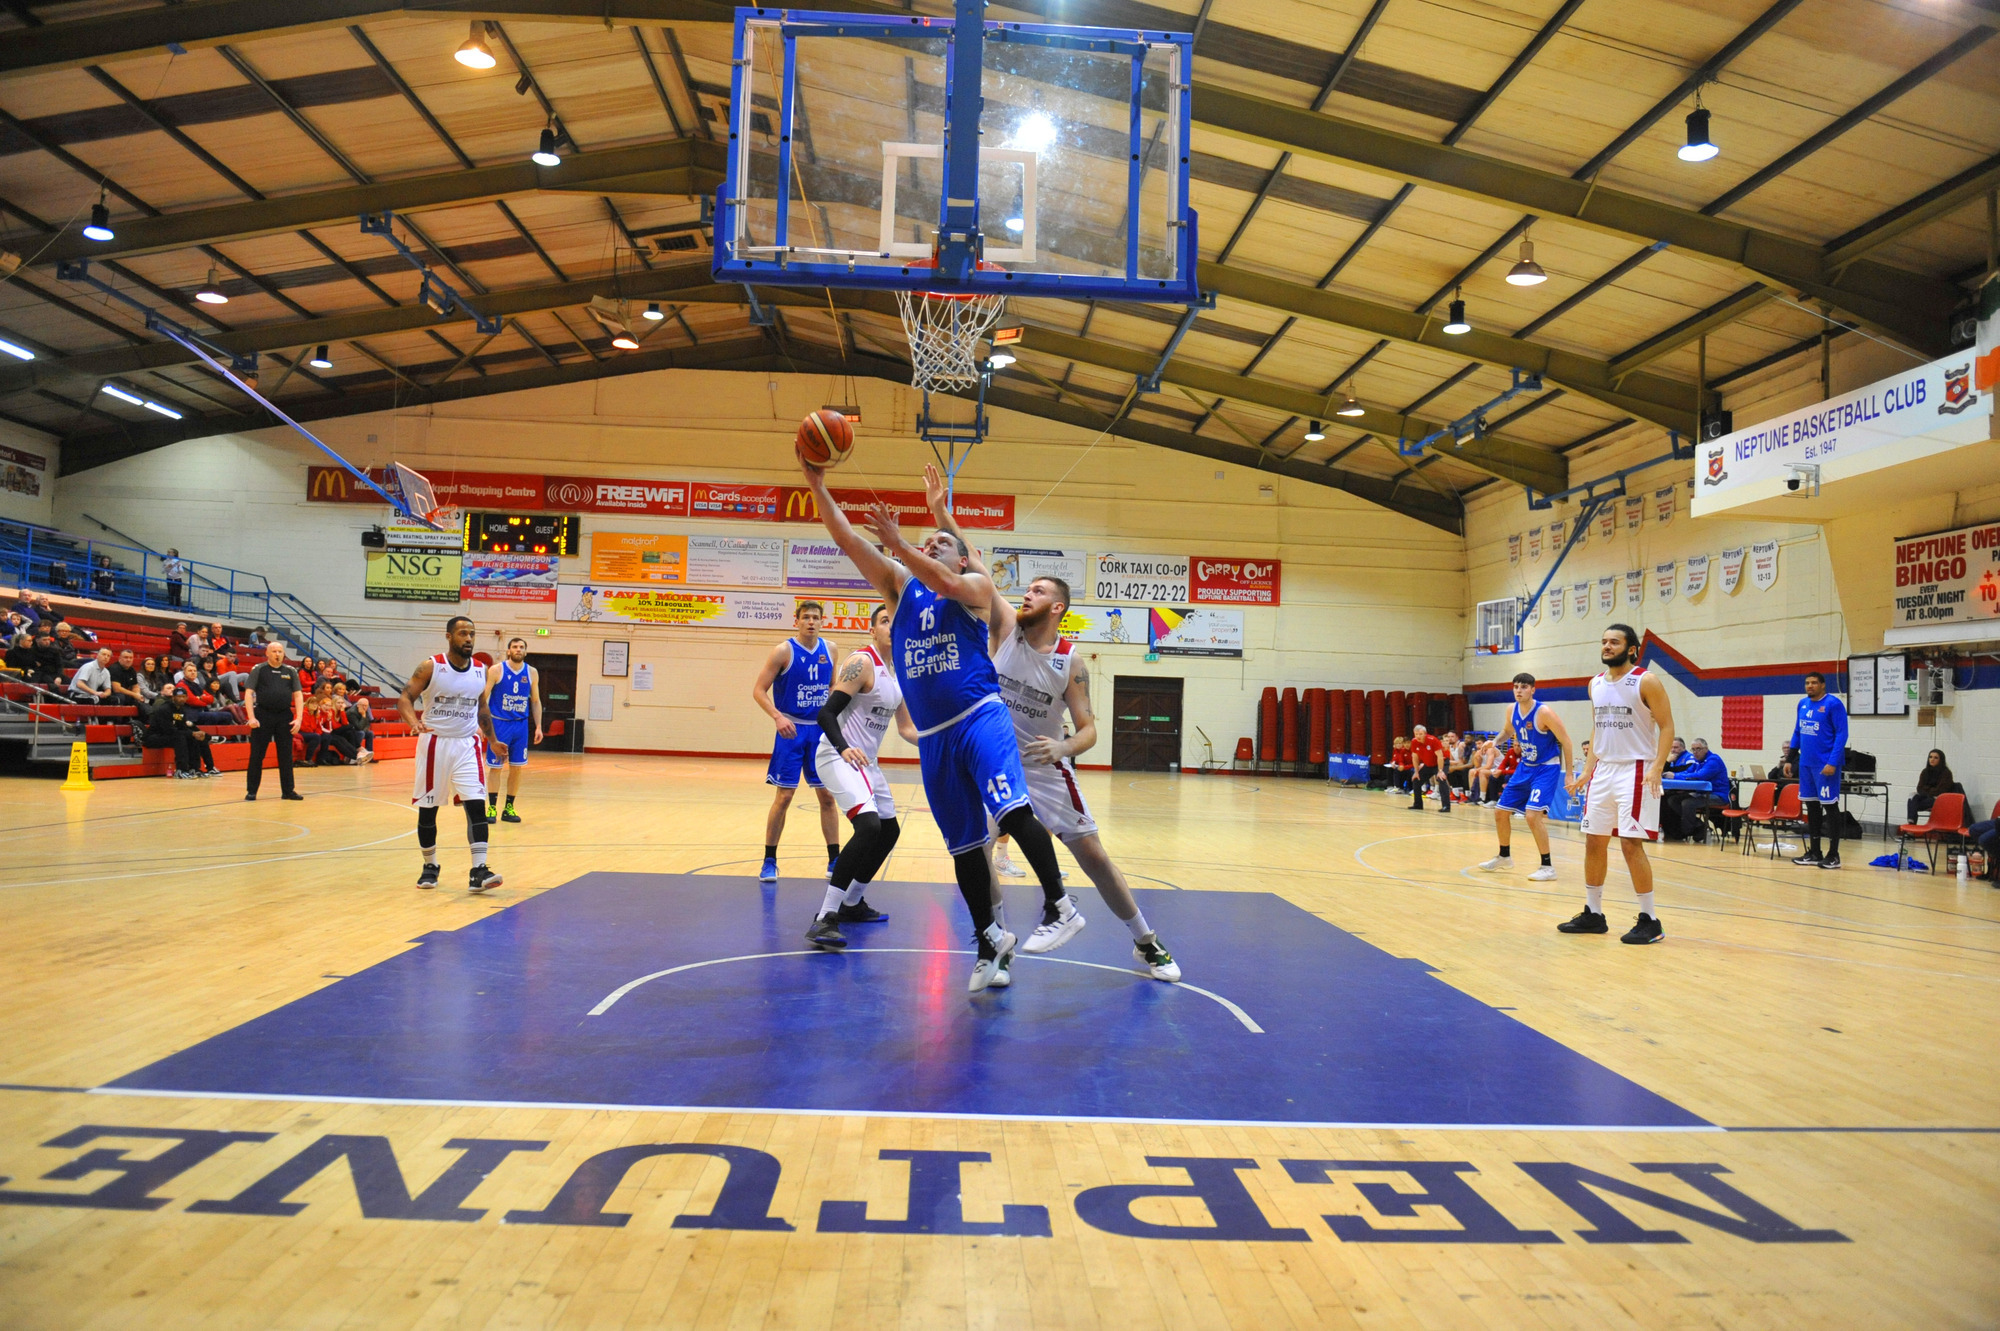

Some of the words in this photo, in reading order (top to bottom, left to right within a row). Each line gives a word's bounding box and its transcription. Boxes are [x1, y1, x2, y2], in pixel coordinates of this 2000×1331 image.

[1735, 424, 1789, 462] NEPTUNE
[1793, 395, 1880, 444] BASKETBALL
[1884, 378, 1927, 414] CLUB
[1805, 446, 1818, 460] Est.
[1820, 438, 1837, 455] 1947
[460, 484, 503, 498] Shopping
[506, 486, 536, 498] Centre
[596, 500, 626, 509] Available
[628, 501, 648, 509] inside
[709, 490, 740, 502] Cards
[742, 495, 777, 506] accepted
[836, 501, 881, 512] cDonald's
[886, 503, 928, 514] Common
[956, 506, 1004, 517] Drive-Thru
[489, 524, 509, 533] HOME
[535, 526, 554, 534] GUEST
[689, 540, 718, 549] Scannell,
[719, 540, 758, 551] O'Callaghan
[760, 542, 769, 550] &
[771, 542, 780, 550] Co
[791, 544, 808, 555] Dave
[808, 545, 838, 557] Kelleher
[1896, 533, 1966, 565] NEPTUNE
[386, 554, 443, 576] NSG
[508, 554, 551, 563] THOMPSON
[506, 562, 540, 570] SERVICES
[1100, 561, 1127, 574] CORK
[1131, 562, 1152, 575] TAXI
[1156, 563, 1187, 576] CO-OP
[1895, 556, 1967, 588] BINGO
[1757, 572, 1771, 581] 12-13
[1097, 582, 1186, 602] 021-427-22-22
[1197, 588, 1228, 596] PROUDLY
[1229, 588, 1272, 597] SUPPORTING
[1920, 584, 1939, 594] EVERY
[1979, 583, 1997, 602] TO
[603, 590, 650, 600] SAVE
[655, 592, 725, 604] MONEY!
[1896, 594, 1935, 610] TUESDAY
[1936, 589, 1966, 605] NIGHT
[655, 600, 694, 608] Discount.
[653, 612, 679, 620] booking
[754, 611, 783, 620] 4354959
[919, 605, 935, 632] 15
[1905, 609, 1917, 621] AT
[1918, 606, 1954, 620] 8.00pm
[904, 632, 956, 651] Coughlan
[913, 649, 926, 666] C
[926, 650, 947, 663] and
[946, 643, 960, 661] S
[906, 658, 961, 680] NEPTUNE
[1051, 658, 1064, 671] 15
[475, 670, 482, 678] 11
[807, 663, 819, 681] 11
[512, 681, 519, 694] 8
[797, 683, 830, 693] Coughlan
[1625, 677, 1637, 686] 33
[502, 693, 528, 701] Coughlan
[813, 693, 824, 701] and
[1806, 709, 1814, 719] 41
[523, 747, 528, 760] 8
[987, 773, 1013, 804] 15
[1820, 786, 1830, 798] 41
[426, 795, 434, 804] 11
[1530, 788, 1541, 803] 12
[0, 1123, 1853, 1243] NEPTUNE
